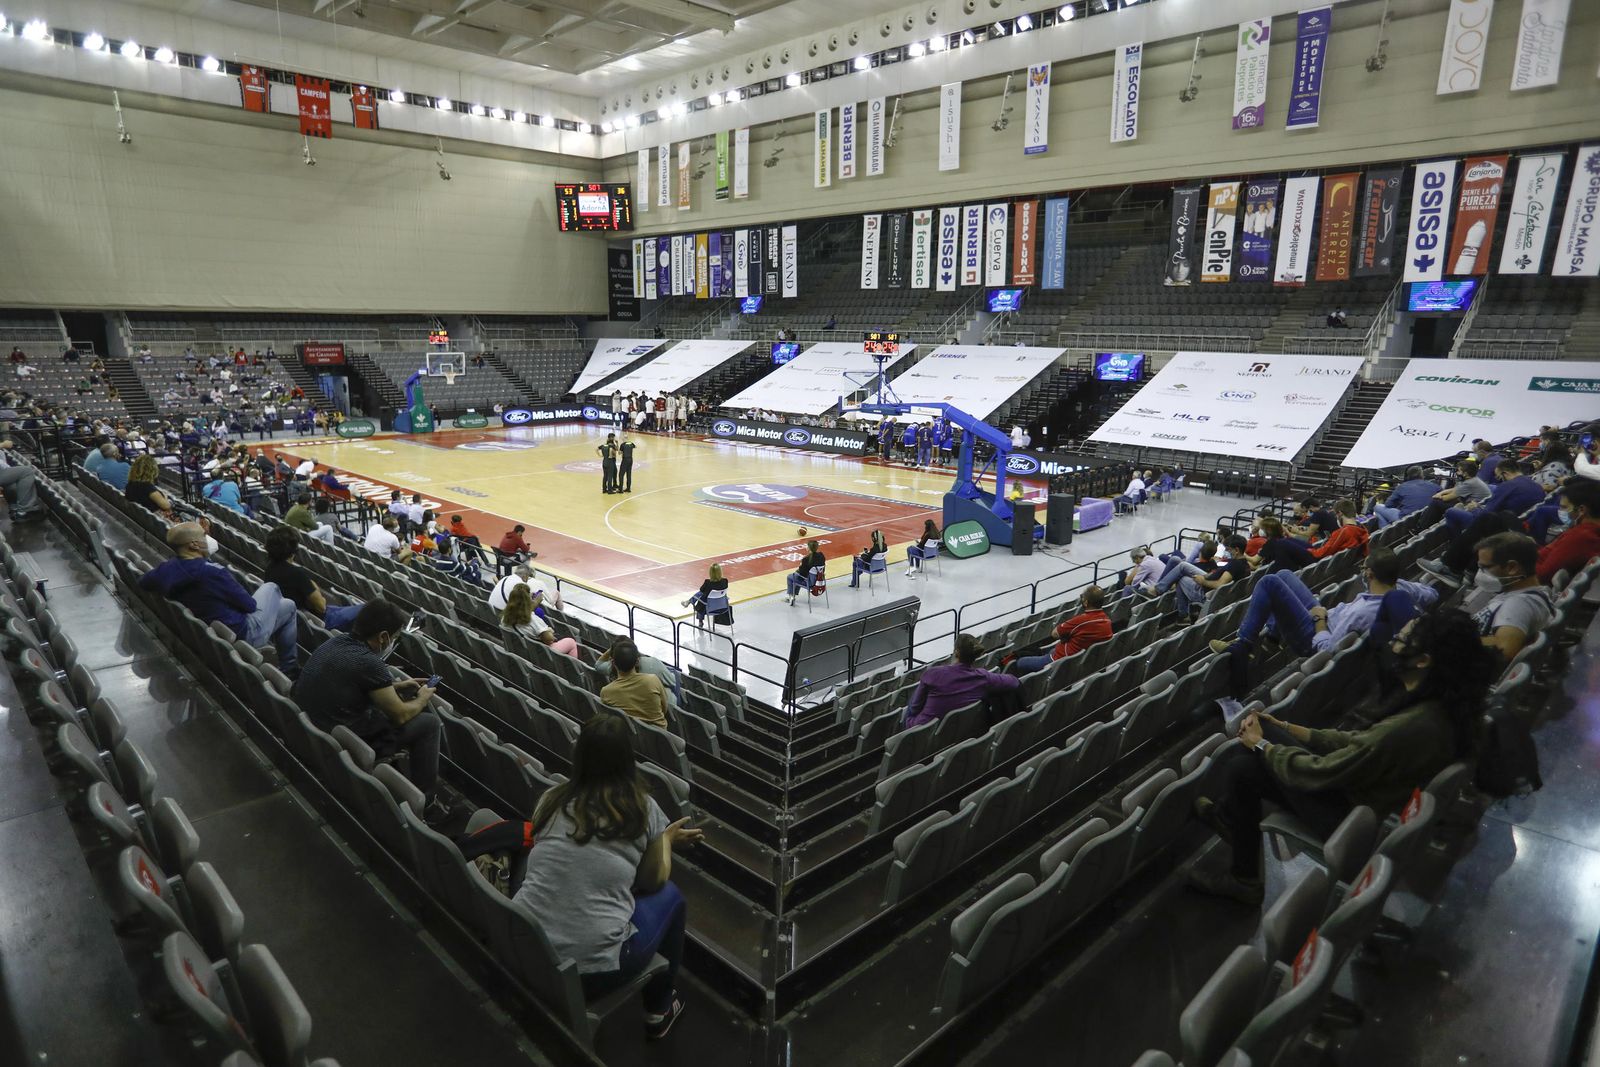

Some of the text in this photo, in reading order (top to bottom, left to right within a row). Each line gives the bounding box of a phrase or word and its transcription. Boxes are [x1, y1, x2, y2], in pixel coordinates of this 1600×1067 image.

[1237, 58, 1248, 102] Deportes
[1247, 56, 1258, 91] Palacio
[1300, 41, 1309, 78] PUERTO
[1308, 39, 1320, 91] MOTRIL
[300, 87, 327, 99] CAMPEÓN
[1125, 65, 1139, 137] ESCOLANO
[1247, 92, 1256, 104] de
[843, 105, 853, 162] BERNER
[1033, 88, 1042, 143] MANZANO
[1241, 112, 1256, 123] 16h
[1468, 166, 1501, 178] Lanjarón
[1022, 202, 1031, 241] GRUPO
[1415, 171, 1446, 251] asisa
[1460, 195, 1497, 206] PUREZA
[941, 214, 955, 269] asisa
[966, 208, 979, 267] BERNER
[1327, 223, 1339, 265] PEREZ
[1337, 211, 1351, 276] ANTONIO
[1569, 175, 1600, 275] GRUPO MAMSA
[783, 238, 795, 290] JURAND
[865, 232, 874, 287] NEPTUNO
[915, 230, 927, 286] fertisac
[993, 228, 1004, 271] Cuerva
[1020, 243, 1029, 273] LUNA
[1207, 230, 1231, 273] enPie
[1296, 366, 1351, 377] JURAND
[532, 410, 554, 419] Mica
[555, 409, 582, 418] Motor
[1389, 424, 1440, 439] Agaz
[1428, 404, 1496, 418] CASTOR
[717, 423, 865, 450] Ford Mica Motor Ford Mica Motor
[1007, 457, 1030, 470] Ford
